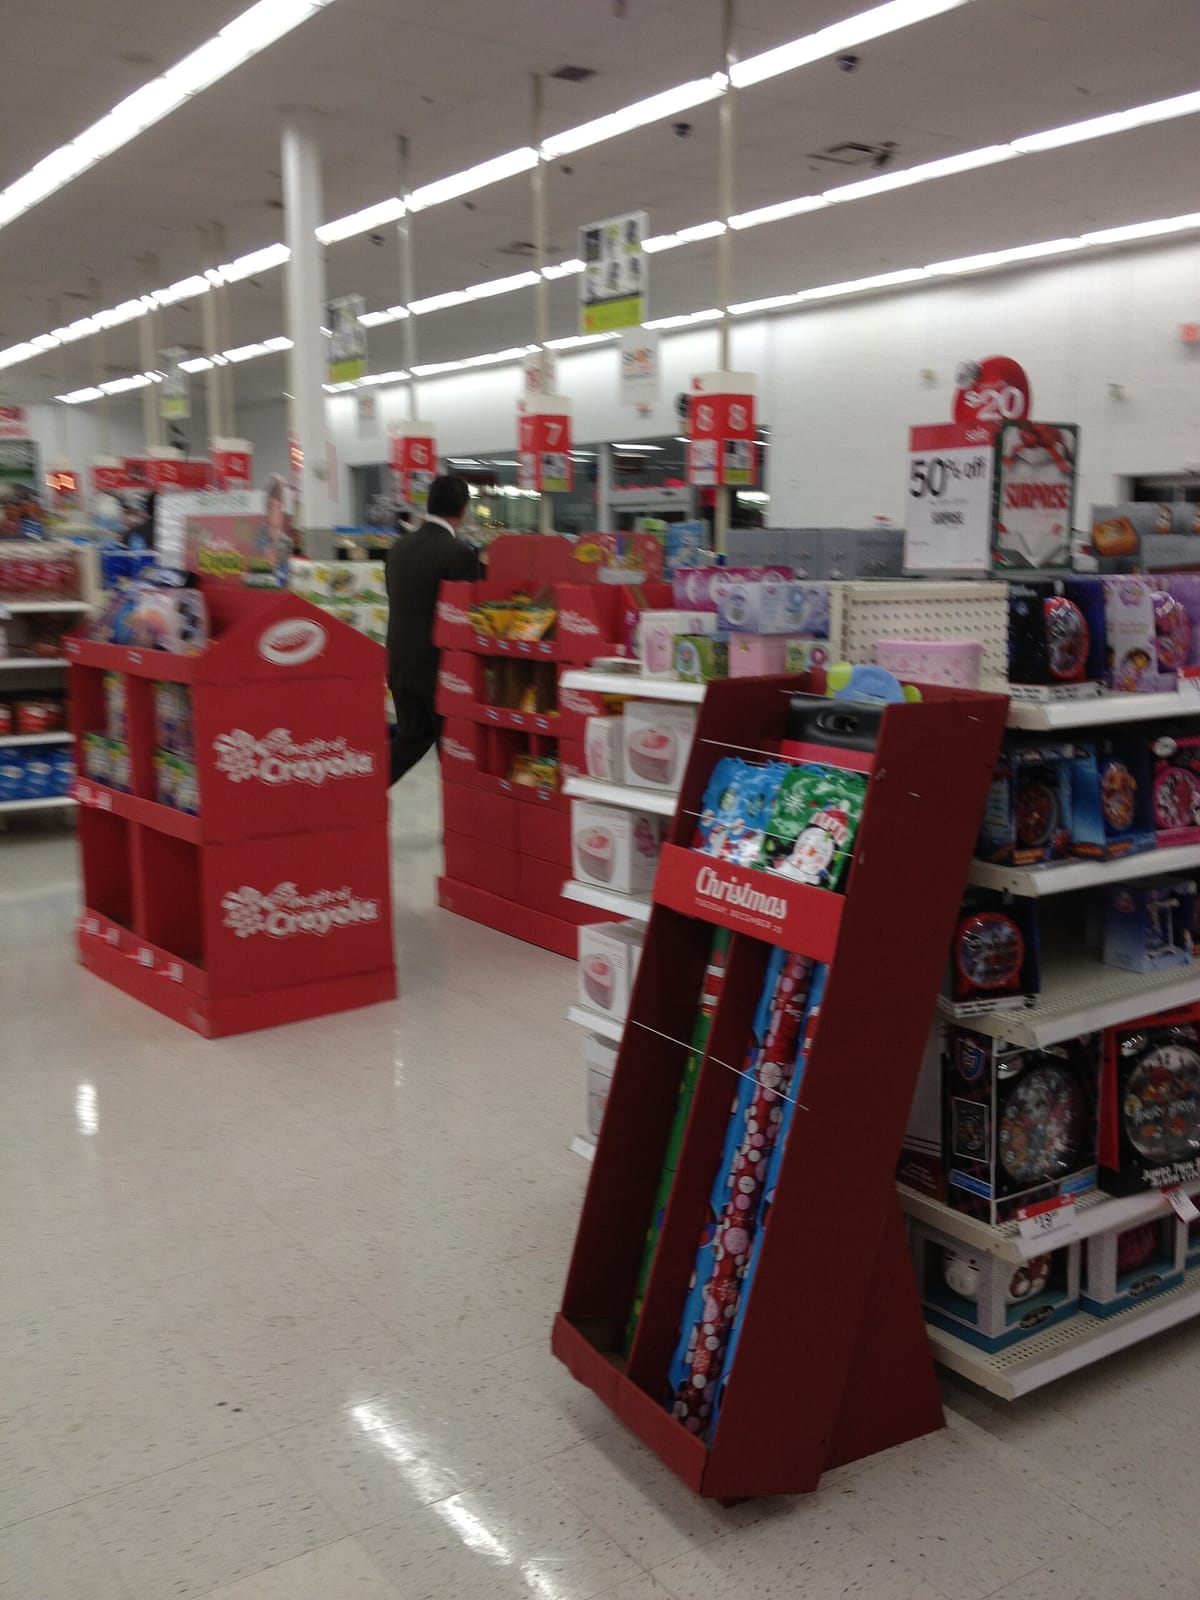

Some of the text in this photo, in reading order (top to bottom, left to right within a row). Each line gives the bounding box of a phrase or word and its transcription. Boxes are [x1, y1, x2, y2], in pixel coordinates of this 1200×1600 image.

[544, 421, 563, 446] 7
[727, 403, 748, 431] 8
[410, 442, 429, 465] 6
[258, 749, 375, 787] Crayola
[696, 866, 788, 920] Christmas
[264, 898, 380, 938] Crayola
